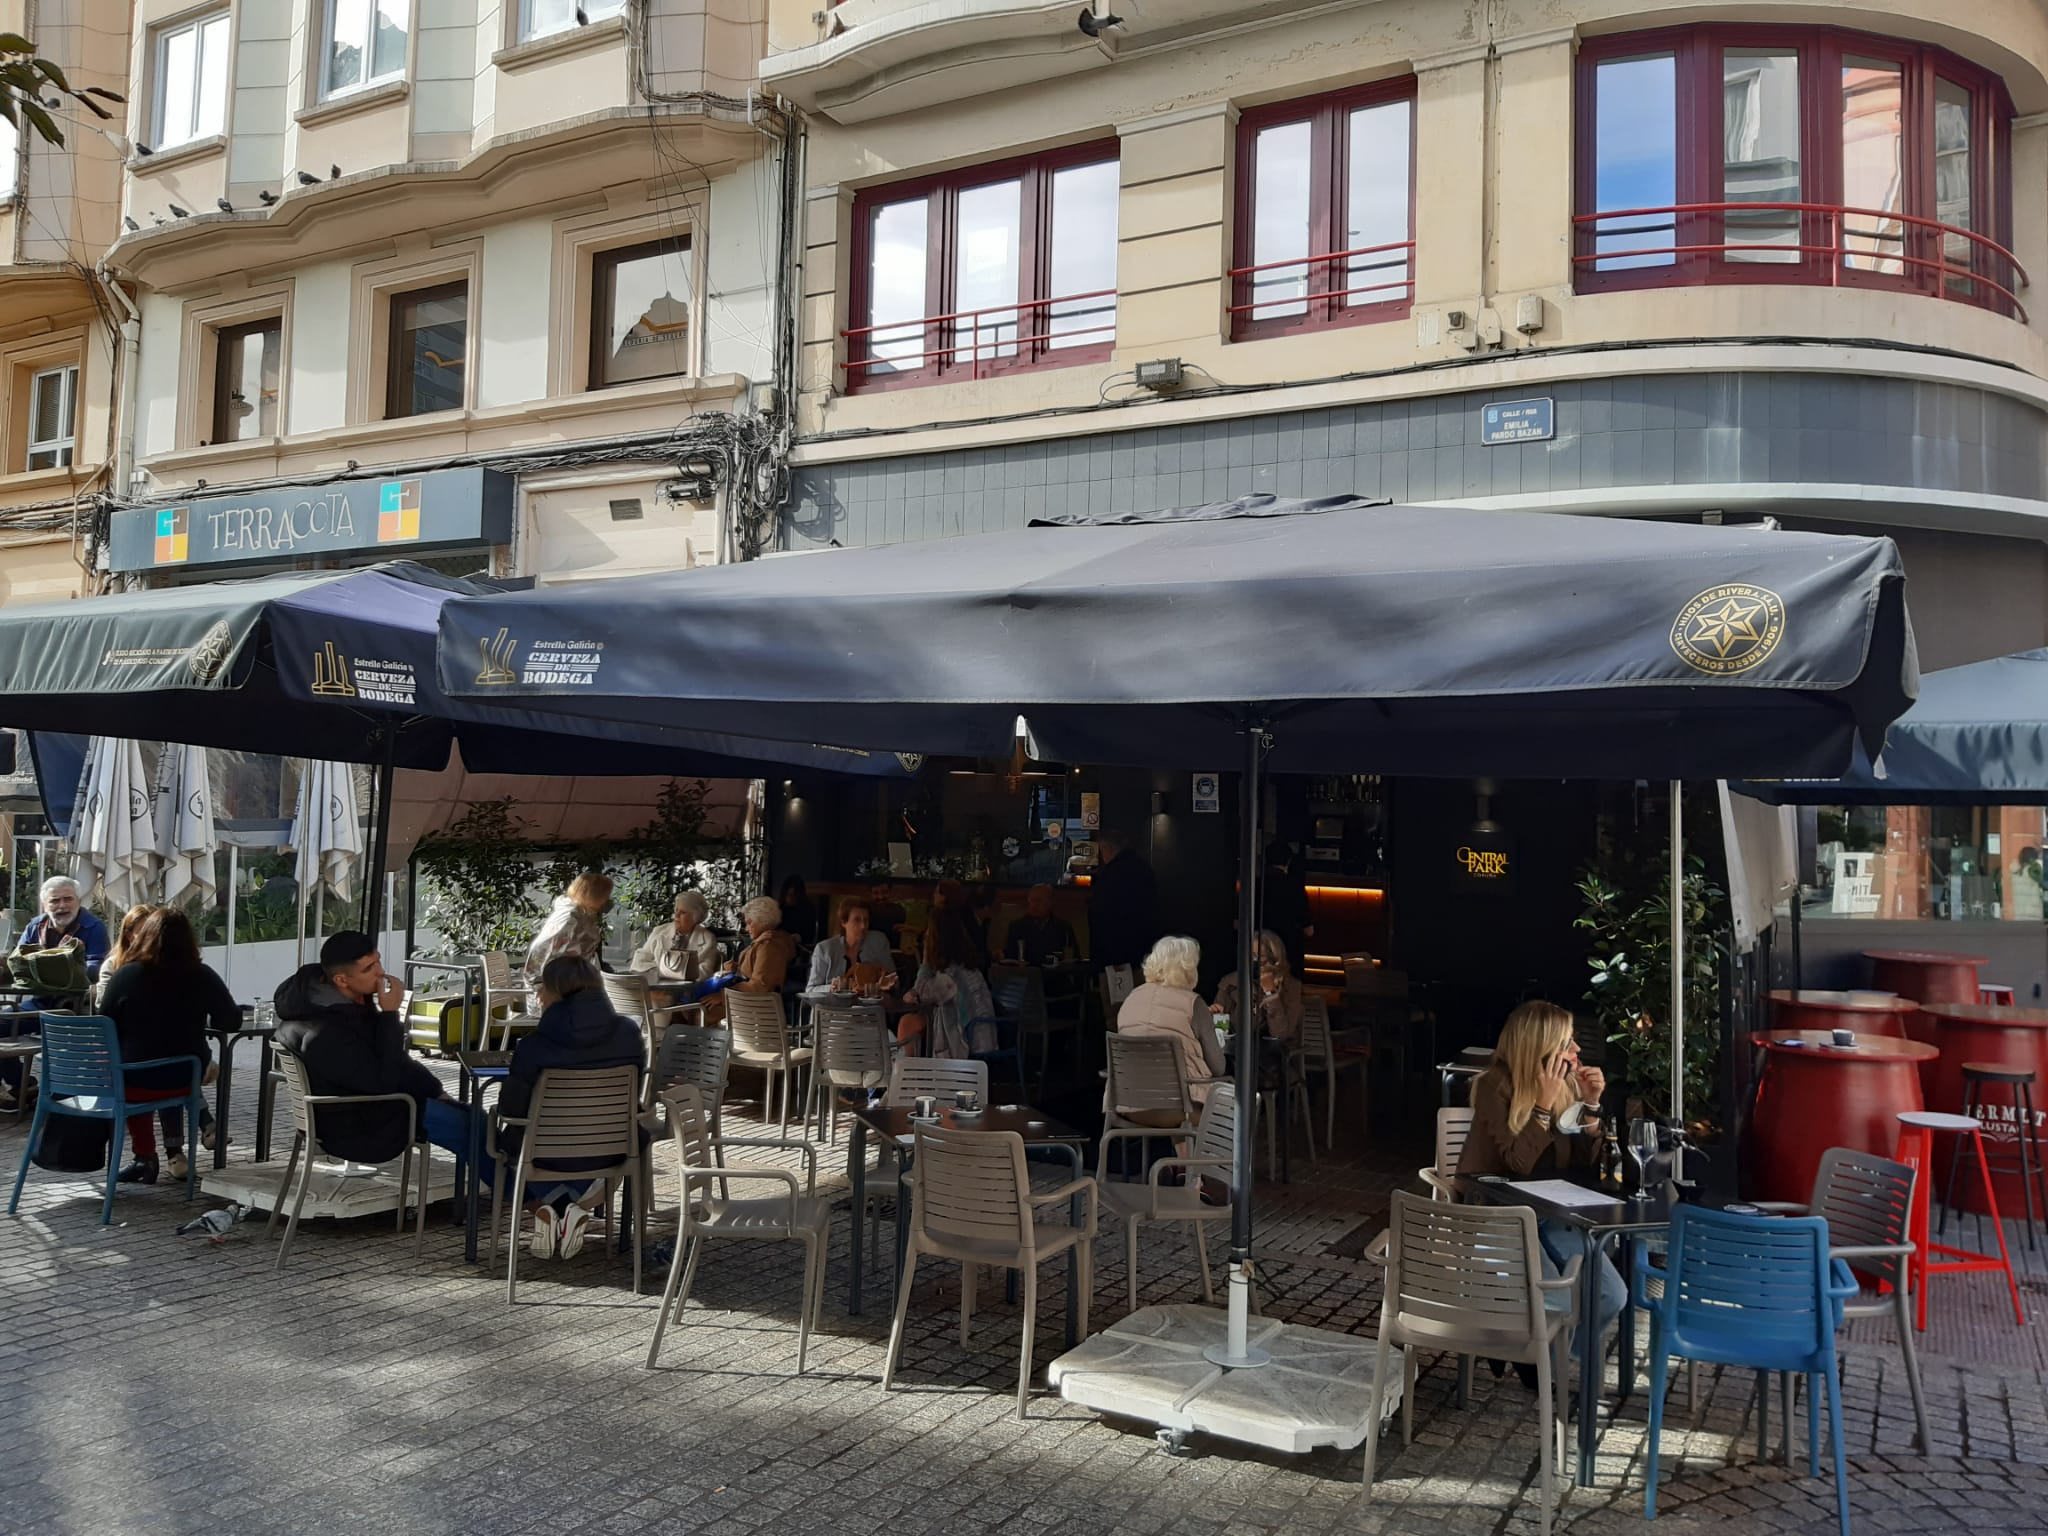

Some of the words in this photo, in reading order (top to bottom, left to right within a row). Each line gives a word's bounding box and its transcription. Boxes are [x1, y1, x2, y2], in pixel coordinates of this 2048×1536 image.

[1502, 410, 1520, 418] CALLE
[1504, 420, 1529, 430] EMILIA
[1491, 430, 1516, 440] PARDO
[208, 491, 356, 551] TERRACOTA
[1679, 602, 1702, 627] HIJOS
[1701, 592, 1717, 604] DE
[532, 640, 566, 649] Estrella
[567, 640, 596, 650] Galicia
[1674, 632, 1725, 670] CERVECEROS
[1727, 650, 1763, 670] DESDE
[1761, 625, 1778, 650] 1906
[353, 657, 381, 669] Estrella
[382, 660, 408, 671] Galicia
[528, 652, 601, 664] CERVEZA
[553, 663, 571, 671] DE
[354, 669, 416, 685] CERVEZA
[522, 671, 594, 684] BODEGA
[378, 682, 392, 691] DE
[358, 688, 416, 704] BODEGA
[1456, 846, 1510, 864] CENTRAL
[1468, 861, 1507, 873] PARK
